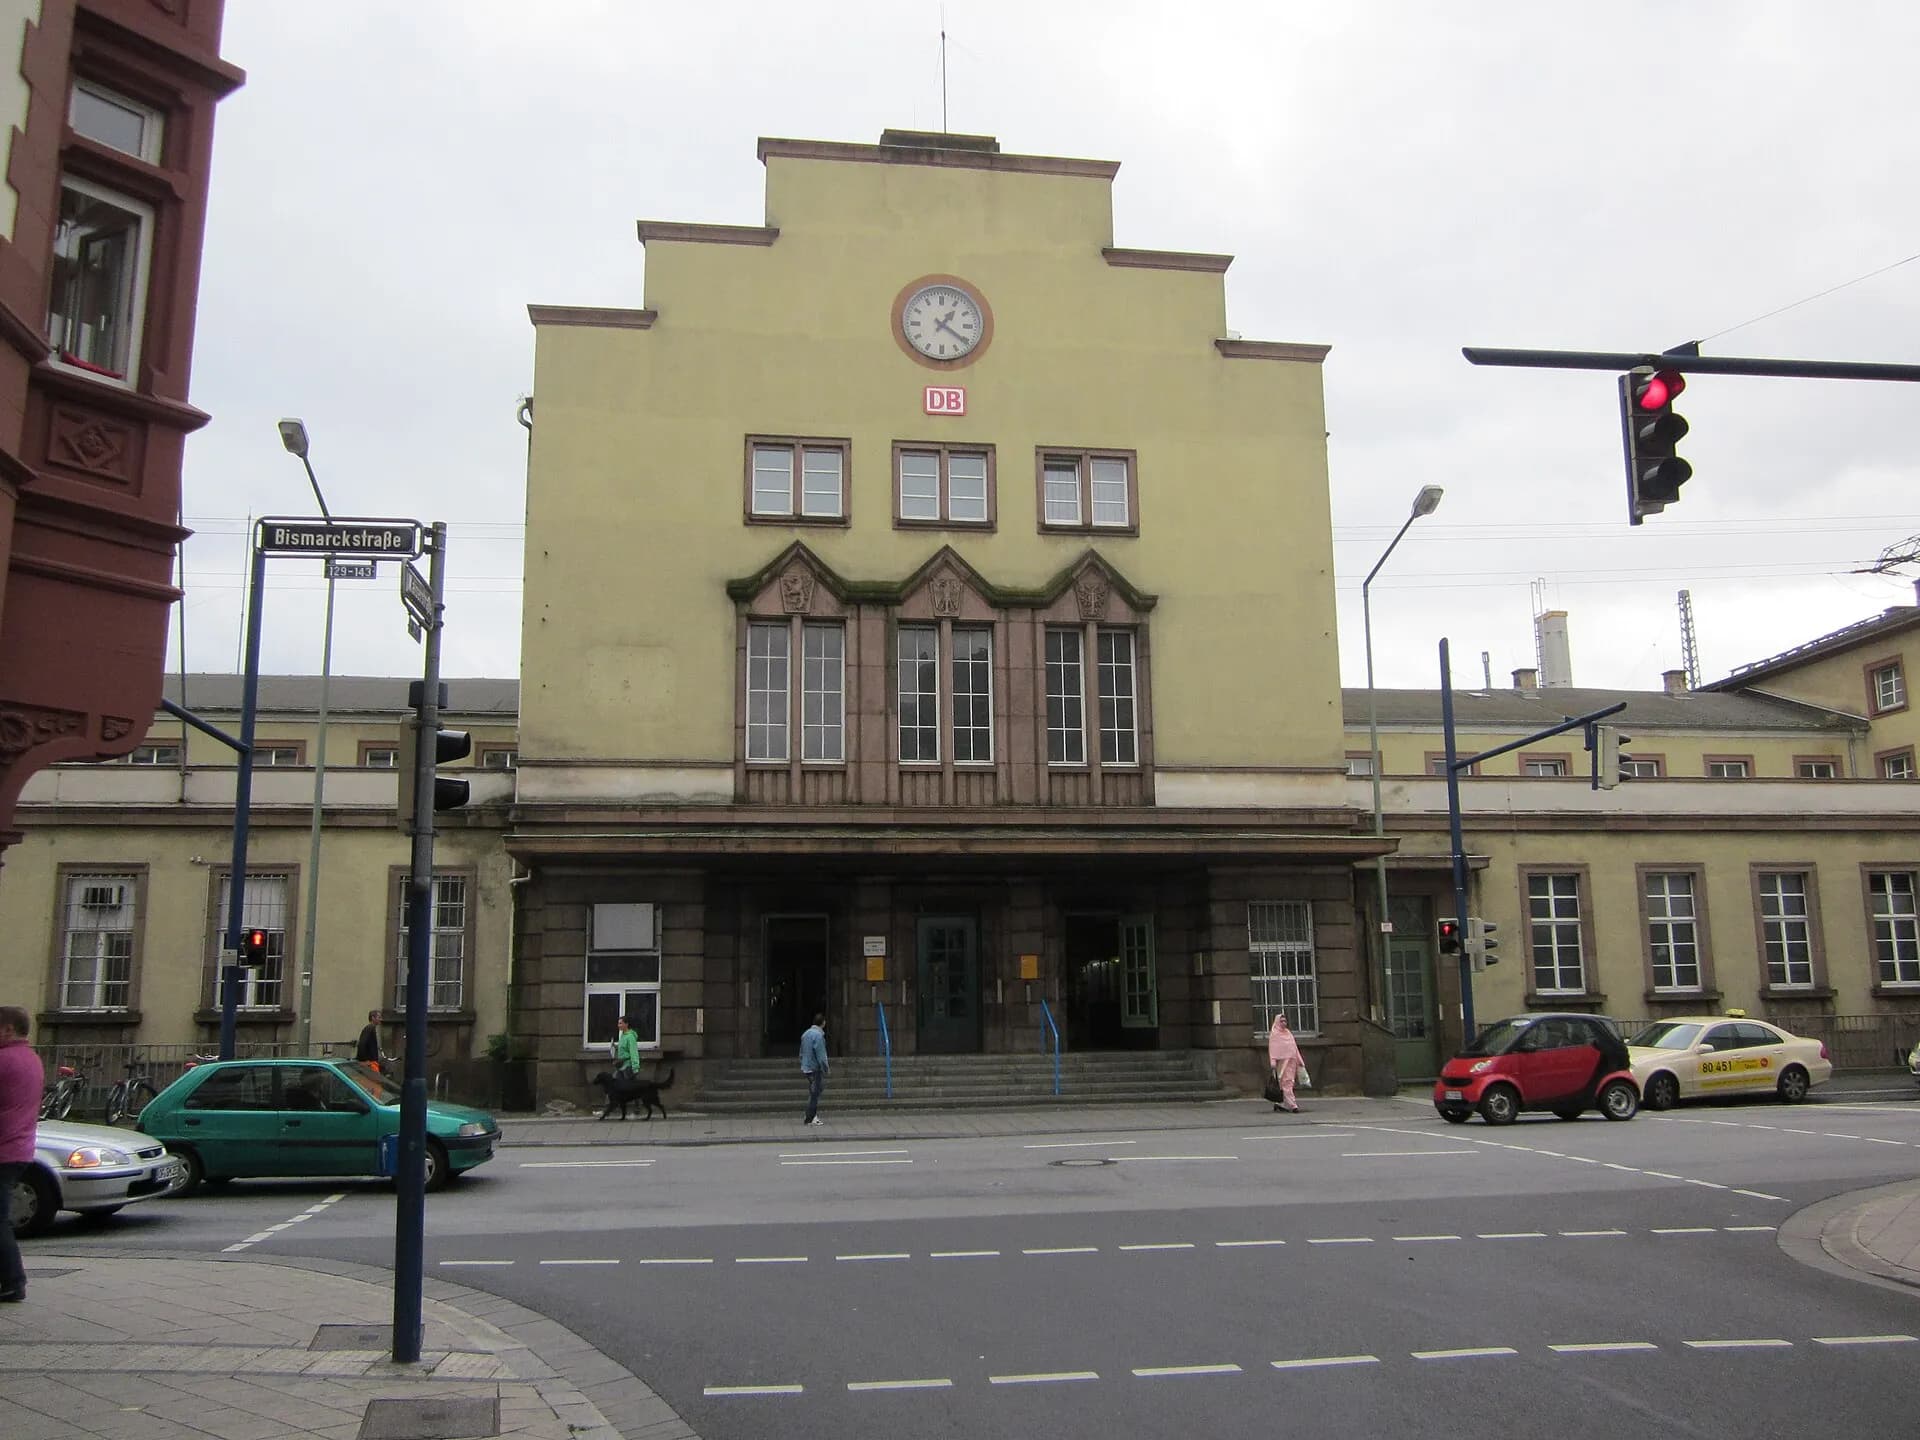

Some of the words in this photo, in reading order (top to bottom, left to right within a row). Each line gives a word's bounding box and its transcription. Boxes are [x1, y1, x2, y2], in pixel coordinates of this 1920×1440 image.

[929, 390, 961, 410] DB
[275, 528, 401, 550] Bismarckstraße
[329, 566, 372, 577] 129-143
[1702, 1062, 1714, 1073] 80
[1715, 1060, 1732, 1072] 451
